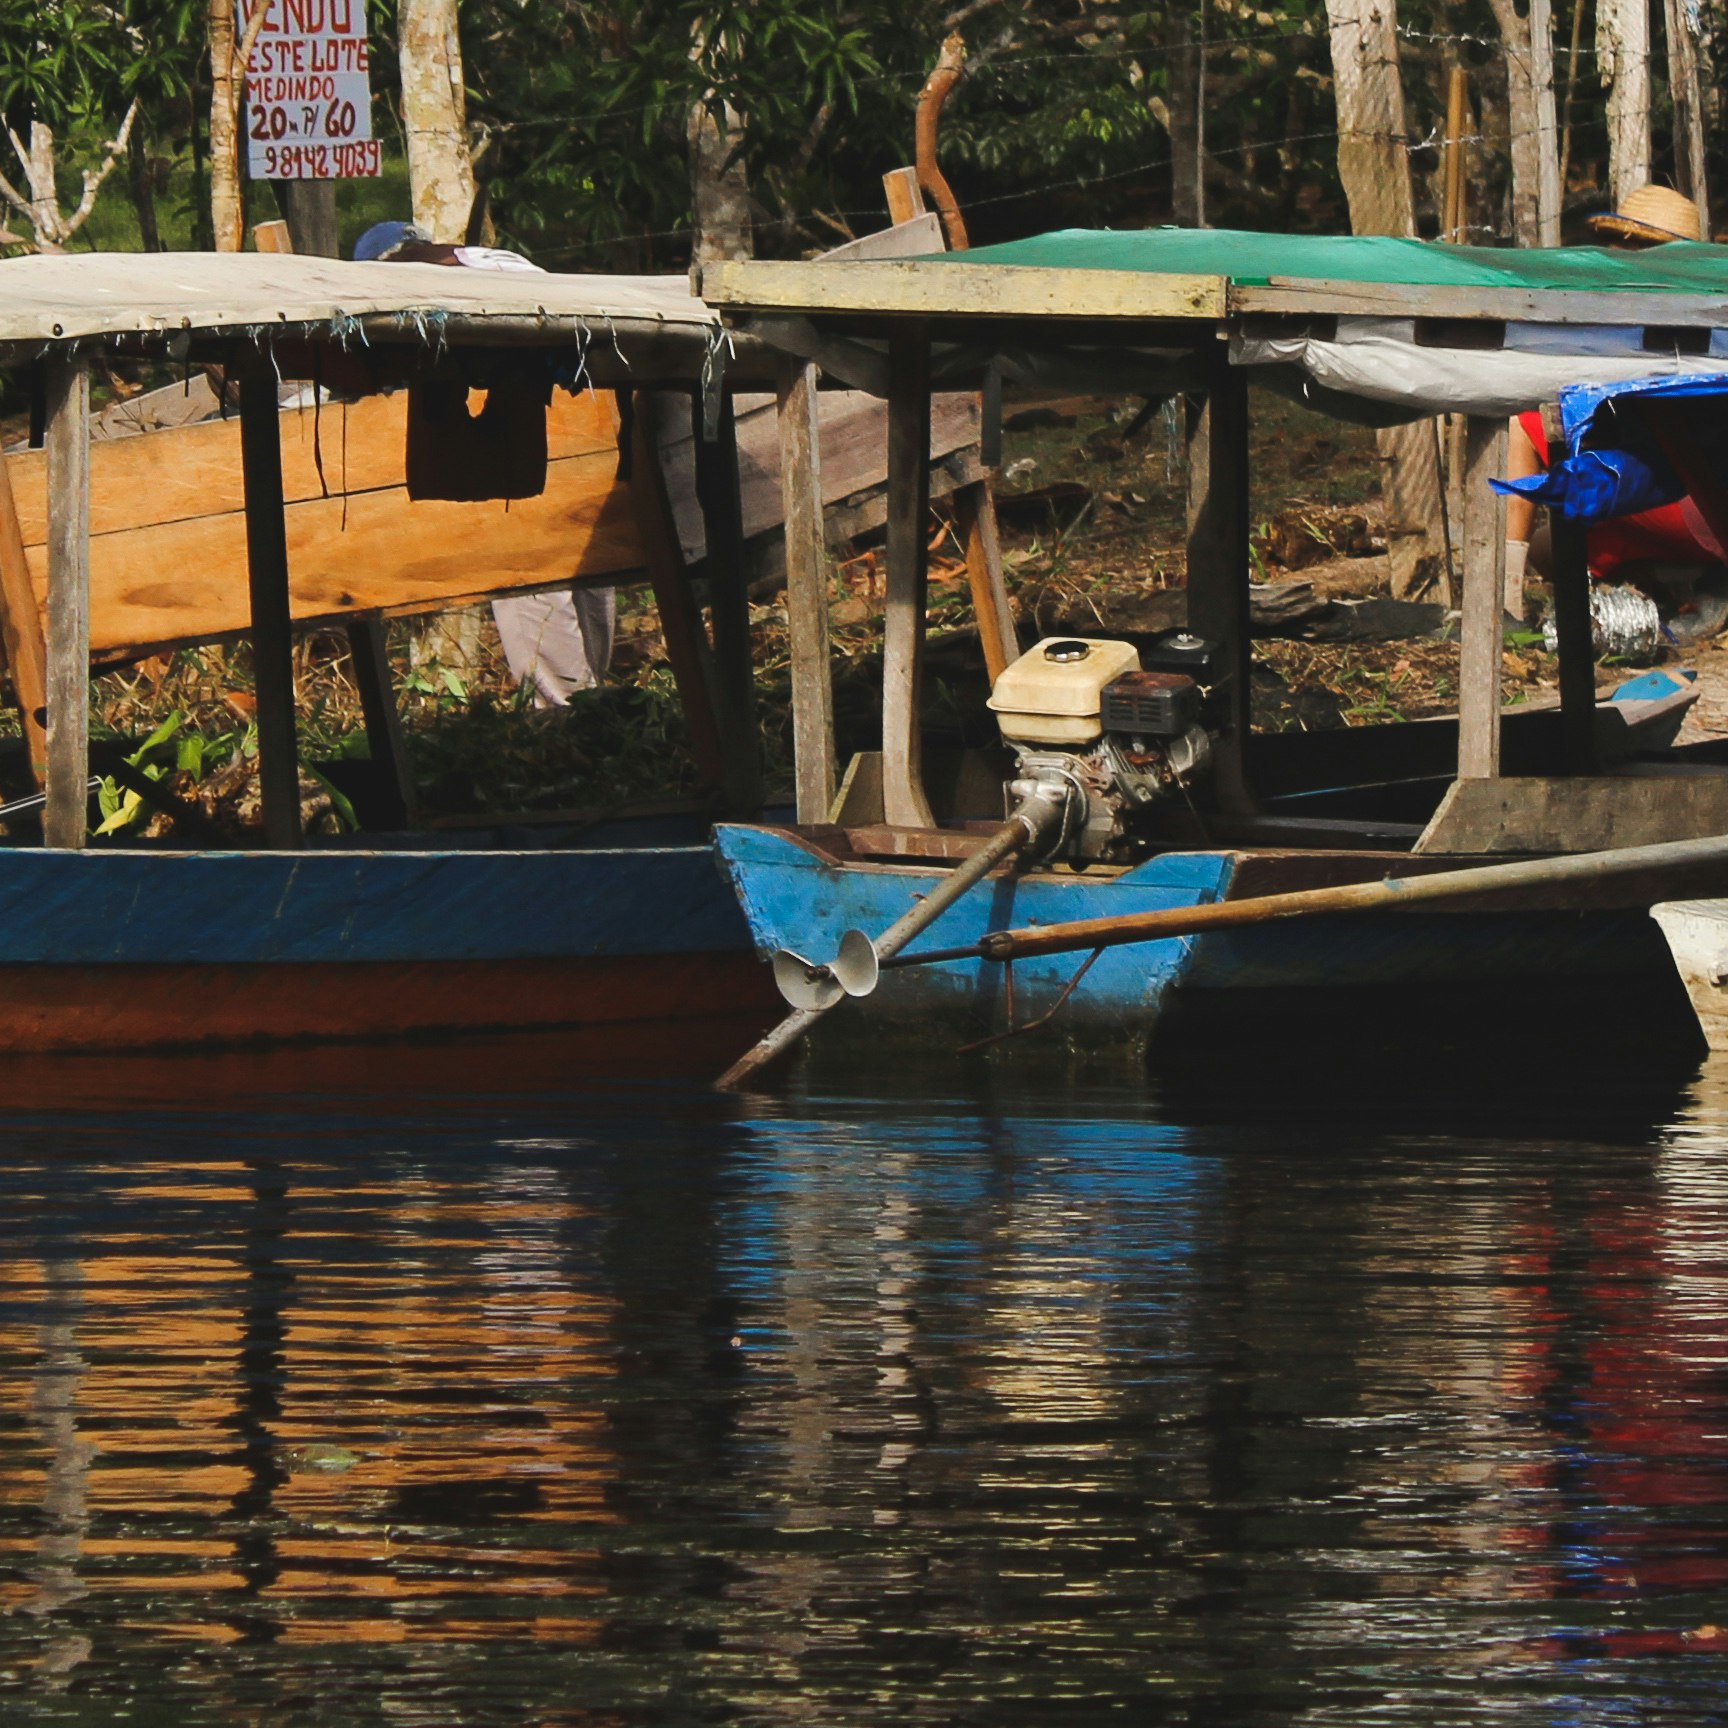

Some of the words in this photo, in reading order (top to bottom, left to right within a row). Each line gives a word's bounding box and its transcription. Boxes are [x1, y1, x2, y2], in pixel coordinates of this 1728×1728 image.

[247, 40, 305, 73] ESTE
[311, 38, 368, 72] LOTE
[245, 76, 334, 102] MEDINDO
[325, 98, 356, 137] 60
